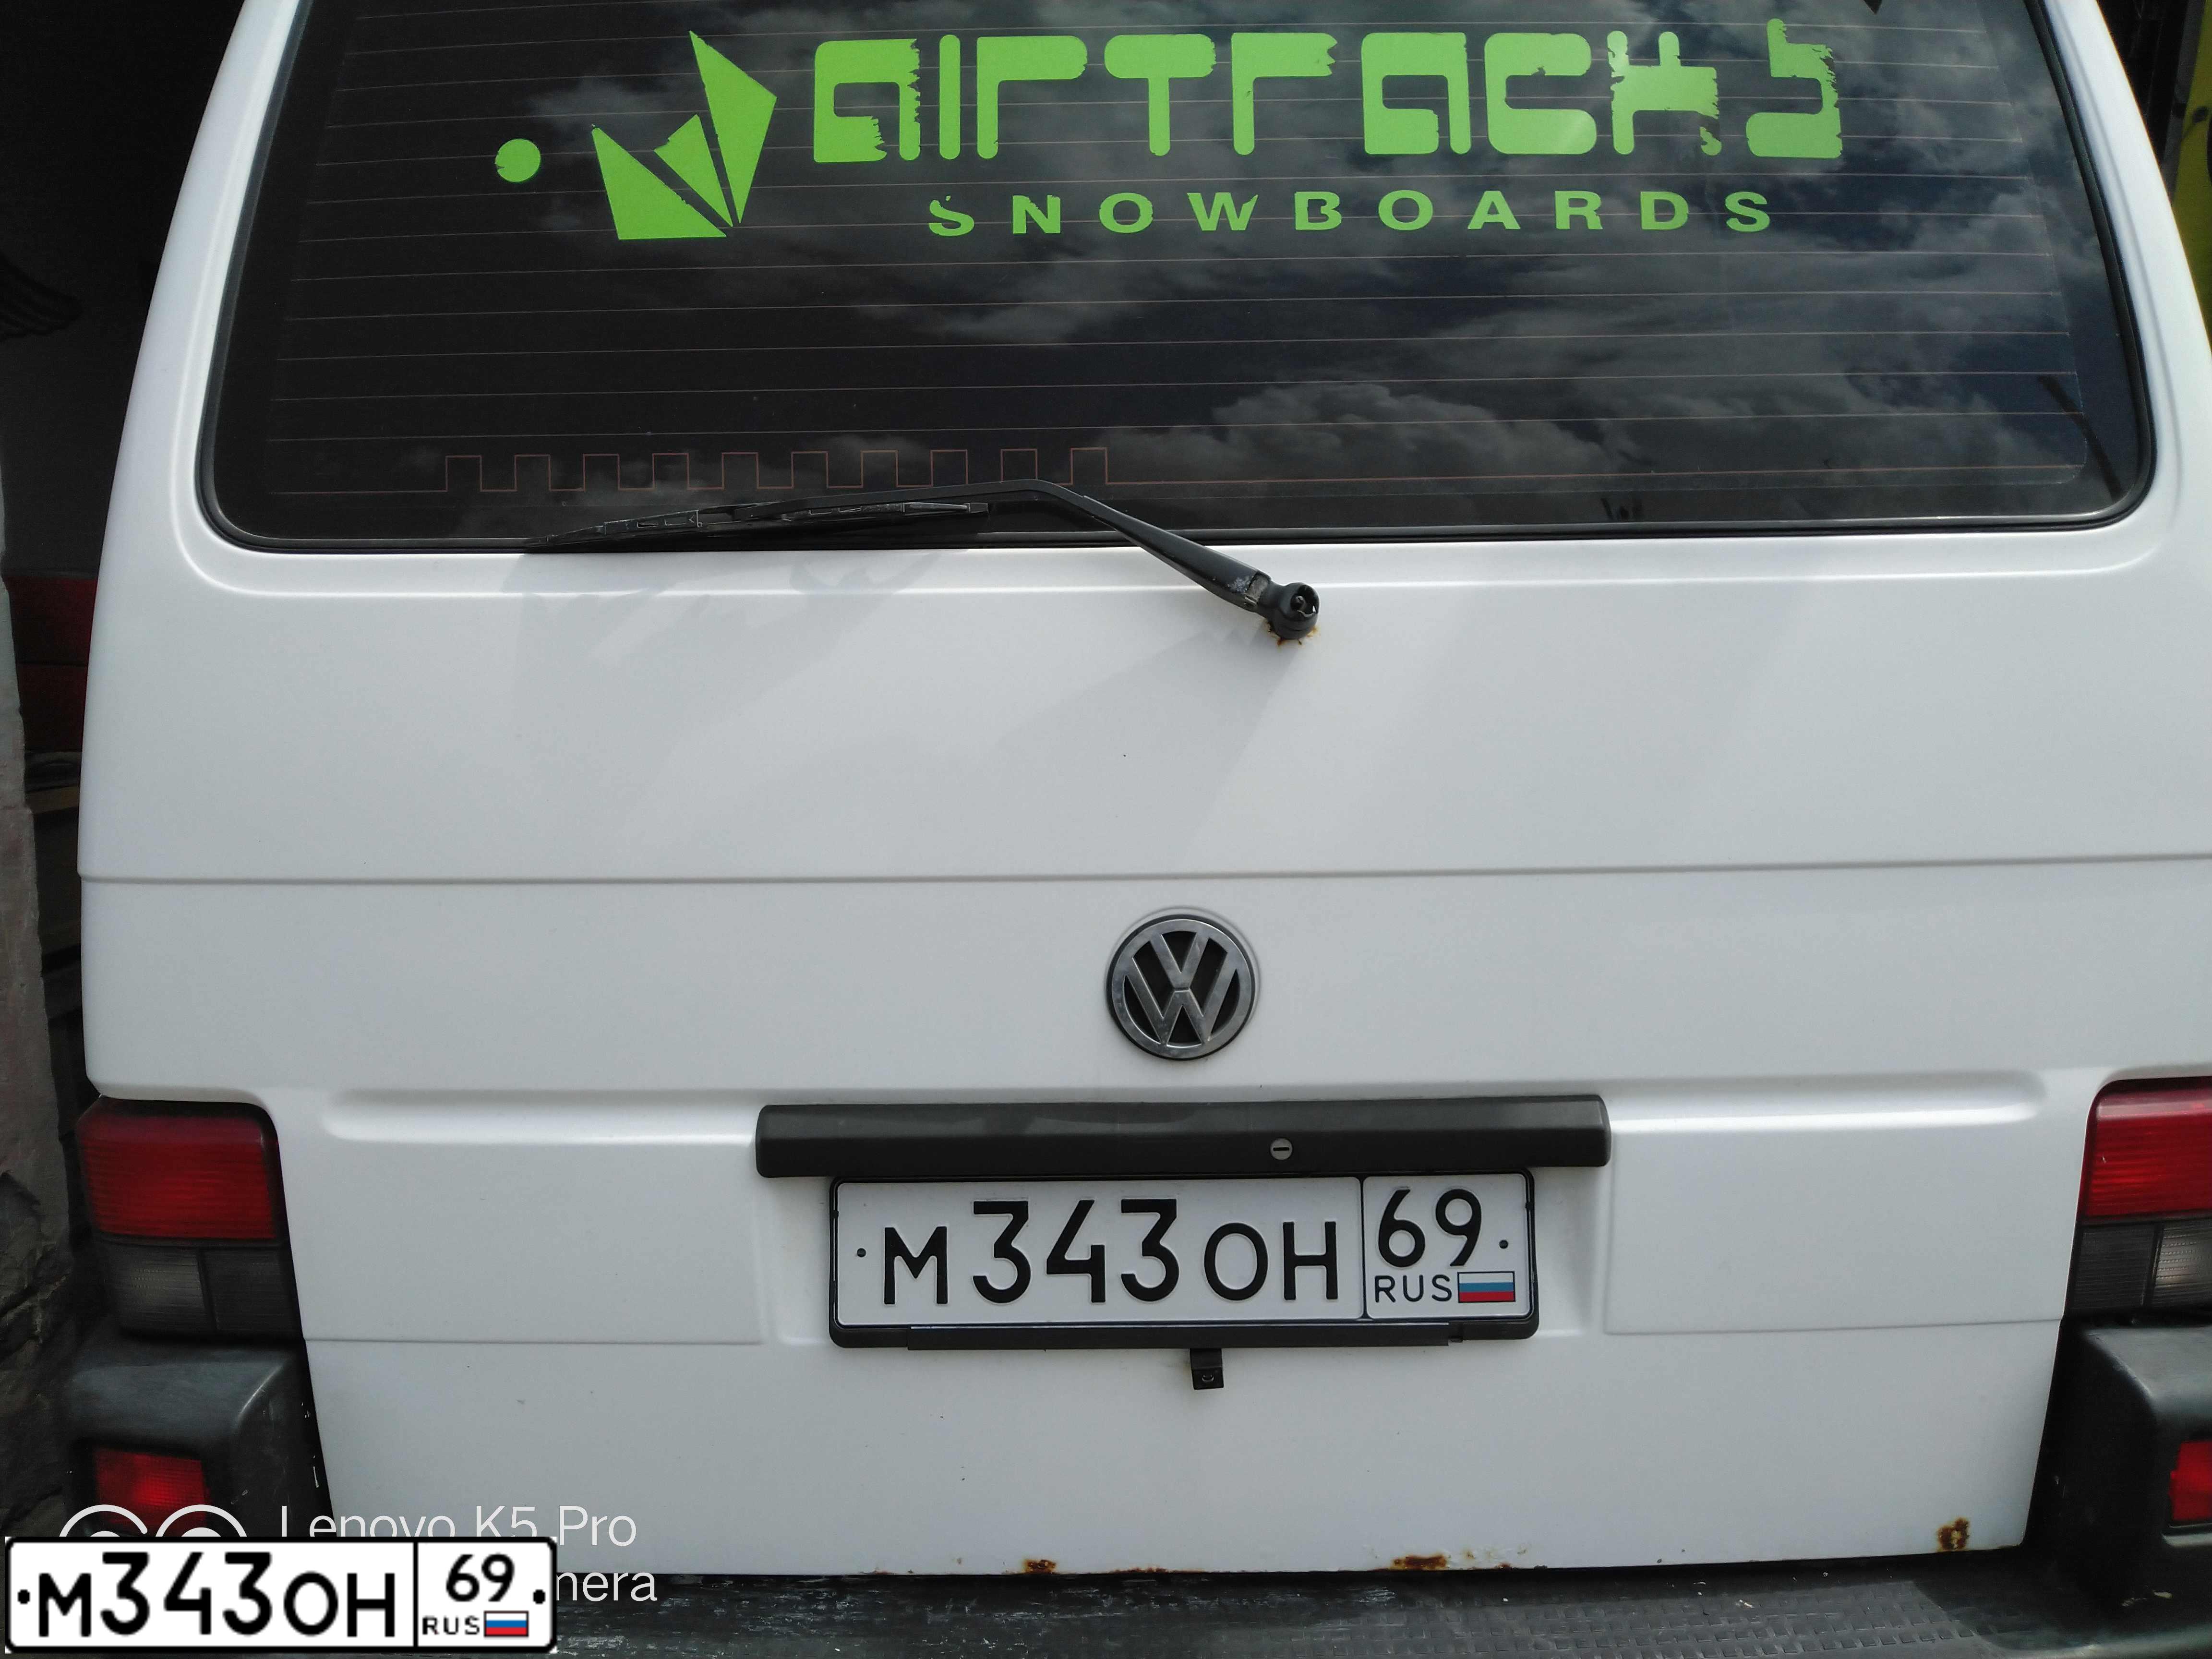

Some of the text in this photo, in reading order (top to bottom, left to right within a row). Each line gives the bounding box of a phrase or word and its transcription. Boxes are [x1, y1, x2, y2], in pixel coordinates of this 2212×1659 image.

[927, 190, 1770, 237] SNOWBOARDS
[1378, 1185, 1482, 1268] 69
[1374, 1274, 1453, 1303] RUS
